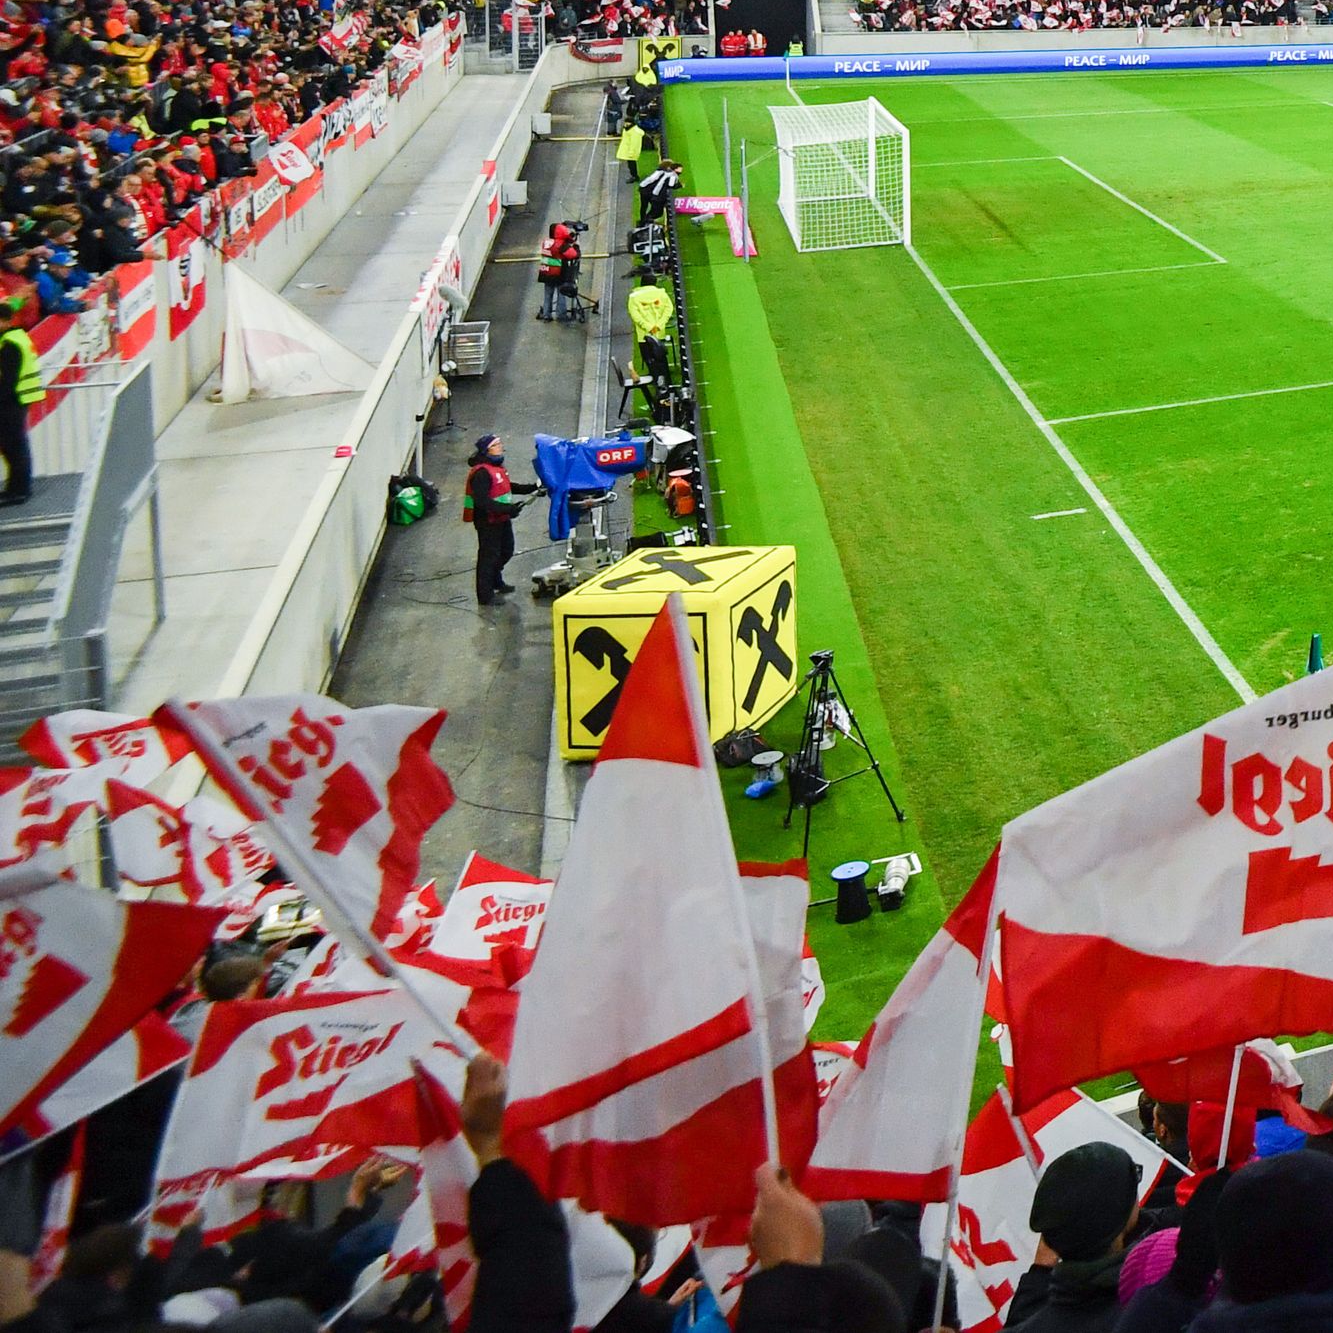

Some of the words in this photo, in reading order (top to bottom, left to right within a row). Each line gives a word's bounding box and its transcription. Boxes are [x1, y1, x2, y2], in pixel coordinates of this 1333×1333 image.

[1065, 55, 1106, 66] PEACE
[1120, 54, 1149, 65] МИР
[1269, 51, 1307, 61] PEACE
[664, 66, 684, 78] МИР
[835, 61, 881, 73] PEACE
[896, 59, 930, 71] МИР
[599, 450, 634, 463] ORF
[254, 1020, 406, 1102] Stiegl
